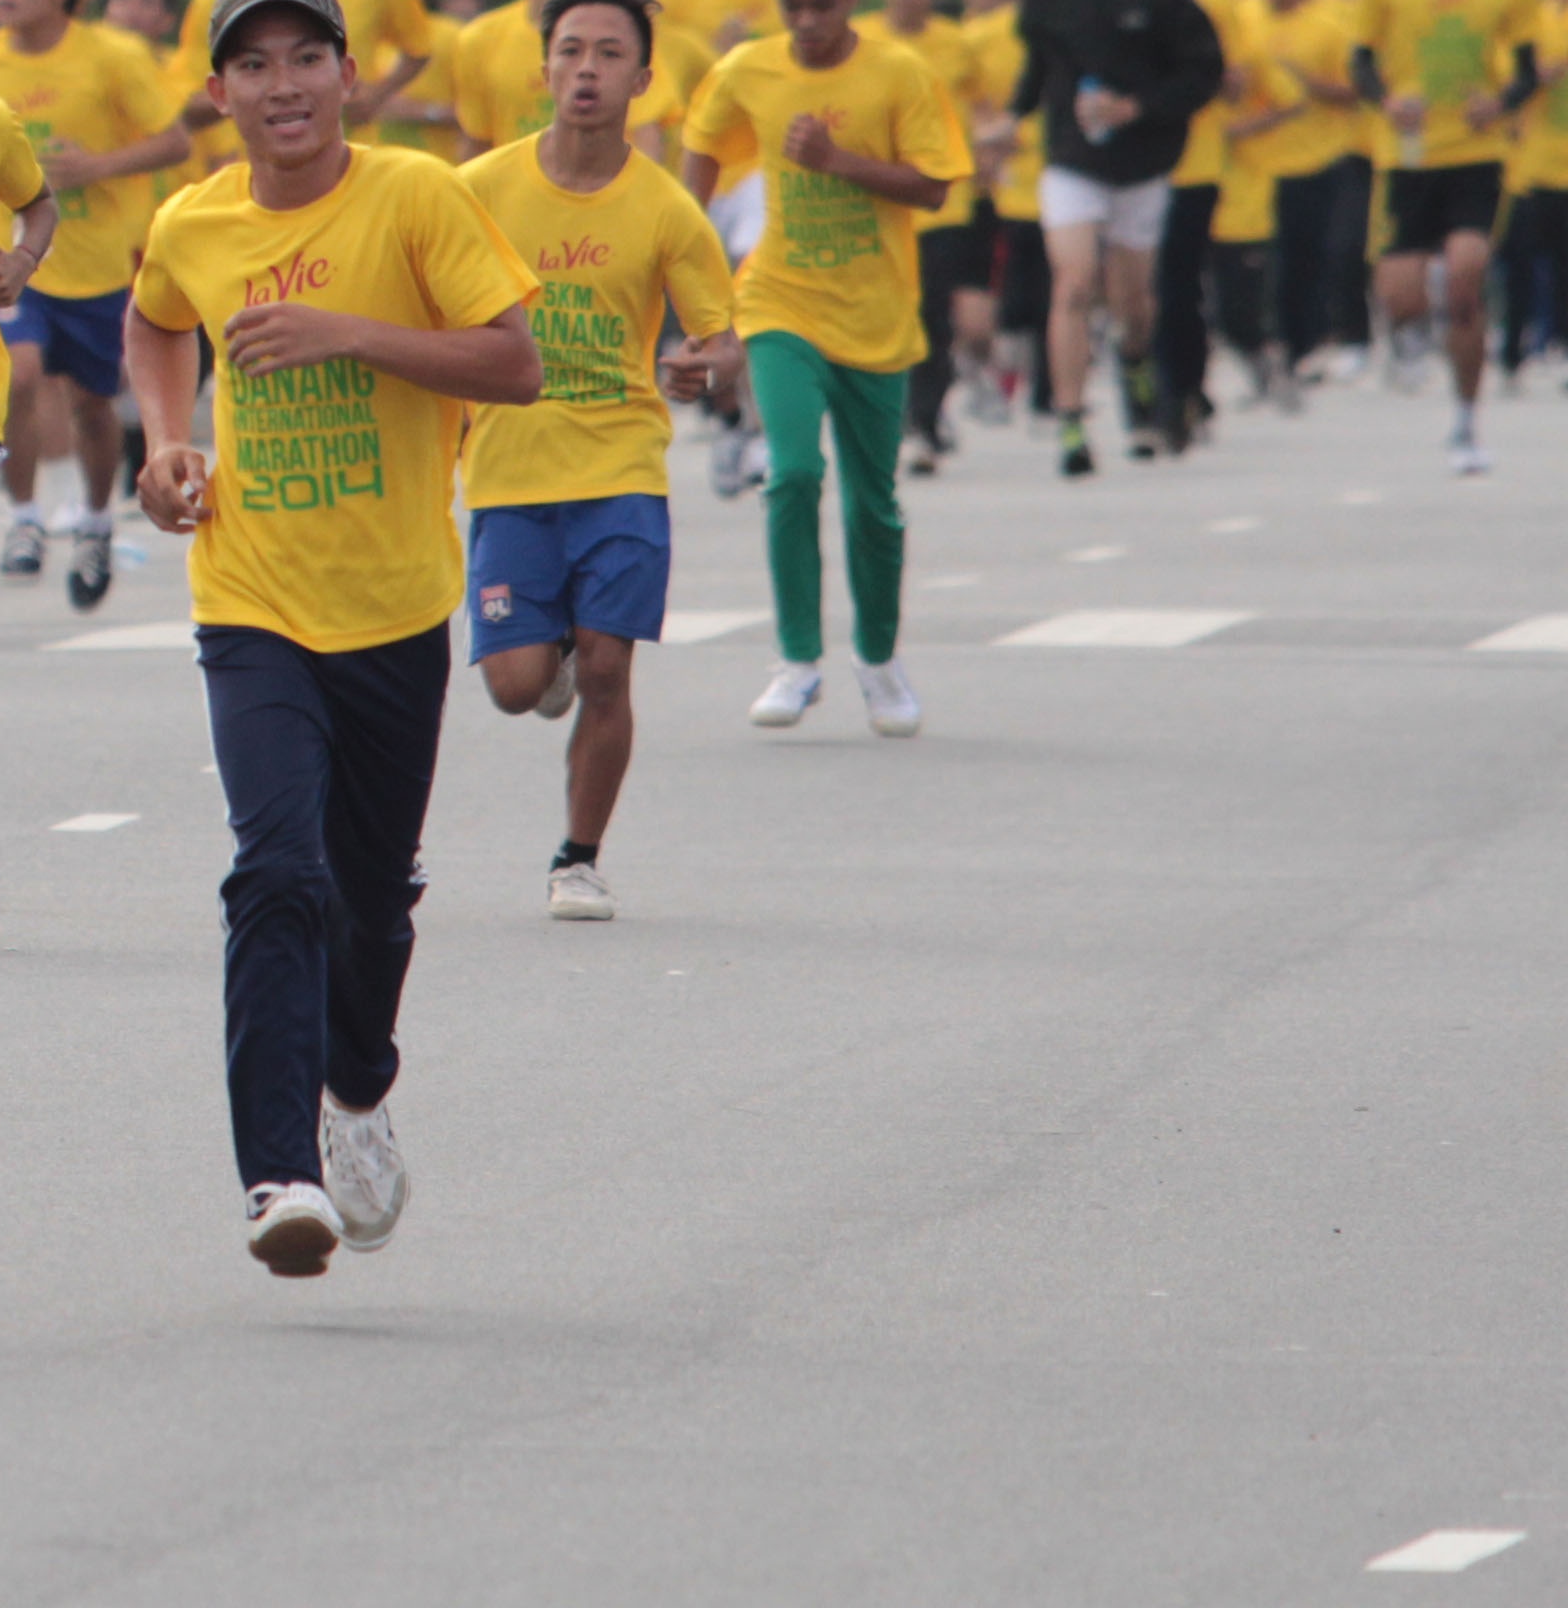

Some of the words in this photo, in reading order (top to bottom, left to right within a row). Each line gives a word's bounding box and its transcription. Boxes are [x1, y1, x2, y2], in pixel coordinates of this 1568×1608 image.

[543, 280, 593, 310] 5KM
[528, 307, 625, 348] ANANG
[228, 358, 376, 406] DANANG
[542, 364, 628, 391] RATHON
[233, 398, 378, 433] INTERNATIONAL
[237, 428, 382, 473] MARATHON
[241, 464, 384, 512] 2014
